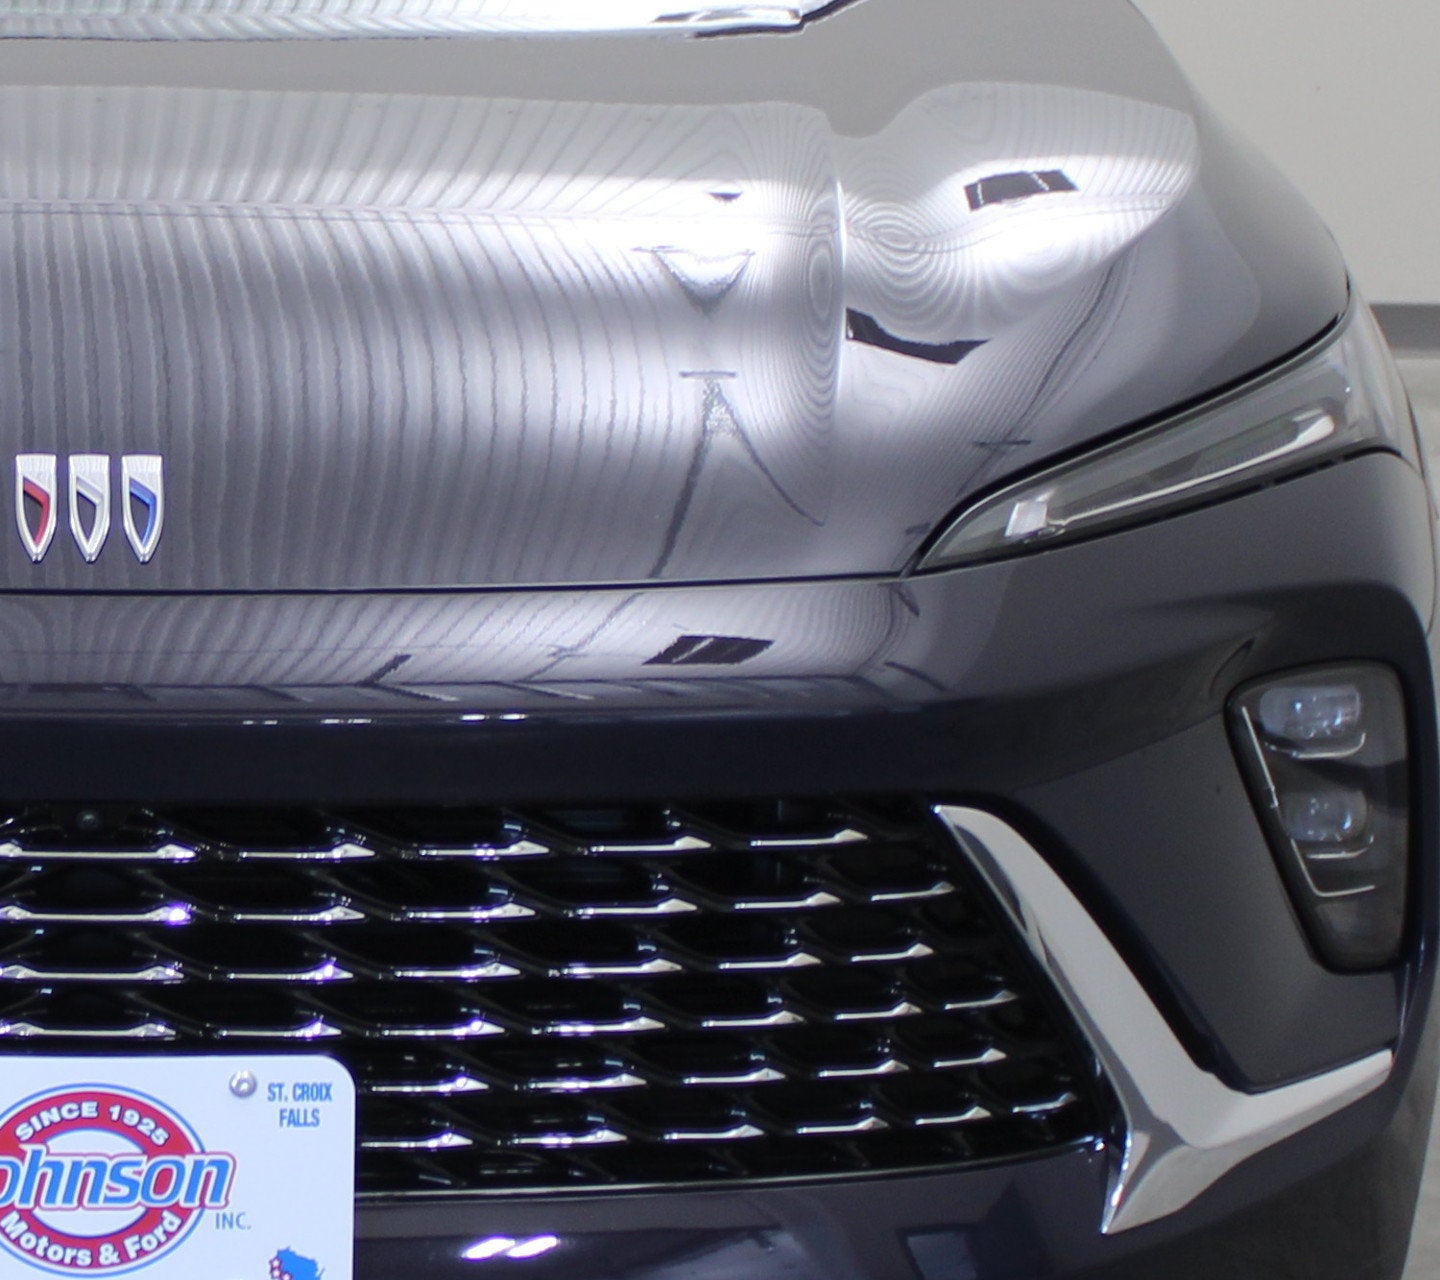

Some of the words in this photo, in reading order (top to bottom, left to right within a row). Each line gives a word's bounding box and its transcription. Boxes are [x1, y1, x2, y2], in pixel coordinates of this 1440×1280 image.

[267, 1083, 288, 1102] ST.
[292, 1083, 333, 1102] CROIX
[14, 1100, 99, 1142] SINCE
[108, 1103, 170, 1147] 1925
[279, 1108, 320, 1127] FALLS
[215, 1211, 252, 1230] INC.
[0, 1210, 92, 1266] Motors
[98, 1243, 120, 1266] &
[123, 1209, 182, 1261] Ford
